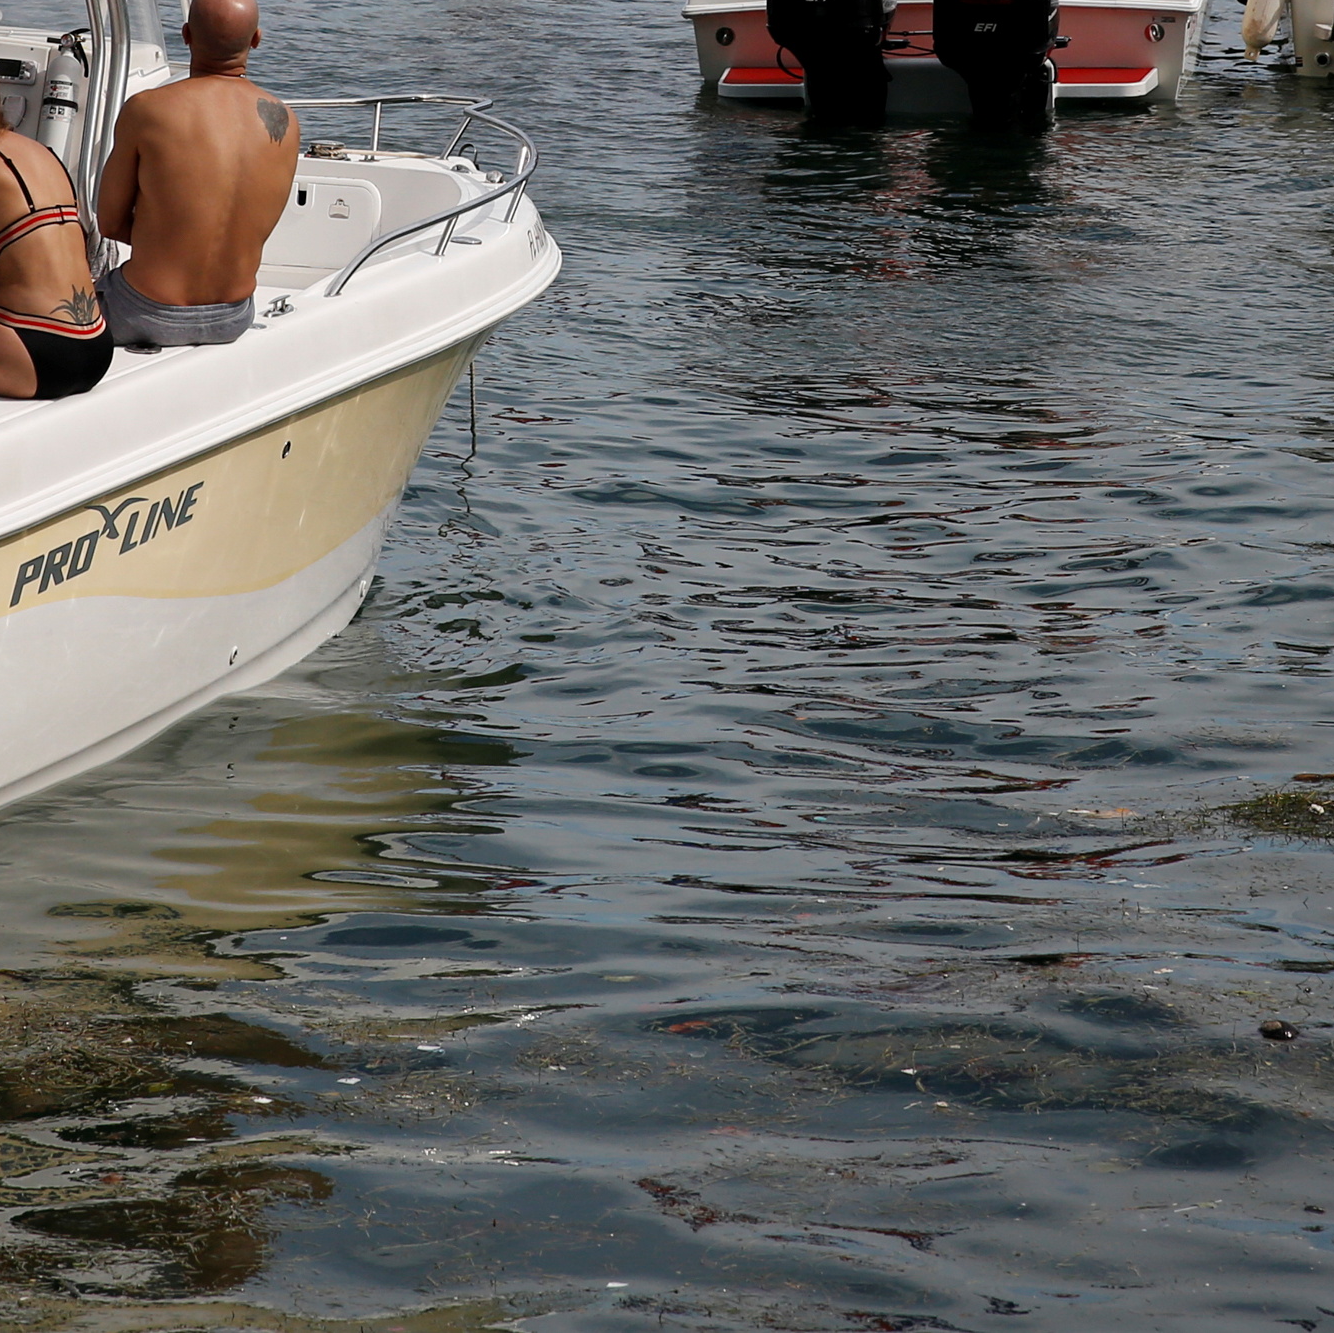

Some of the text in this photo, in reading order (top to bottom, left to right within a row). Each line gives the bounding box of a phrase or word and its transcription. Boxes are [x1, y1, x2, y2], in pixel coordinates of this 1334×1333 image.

[974, 23, 997, 32] EFI
[9, 529, 100, 608] PRO
[119, 481, 205, 556] LINE
